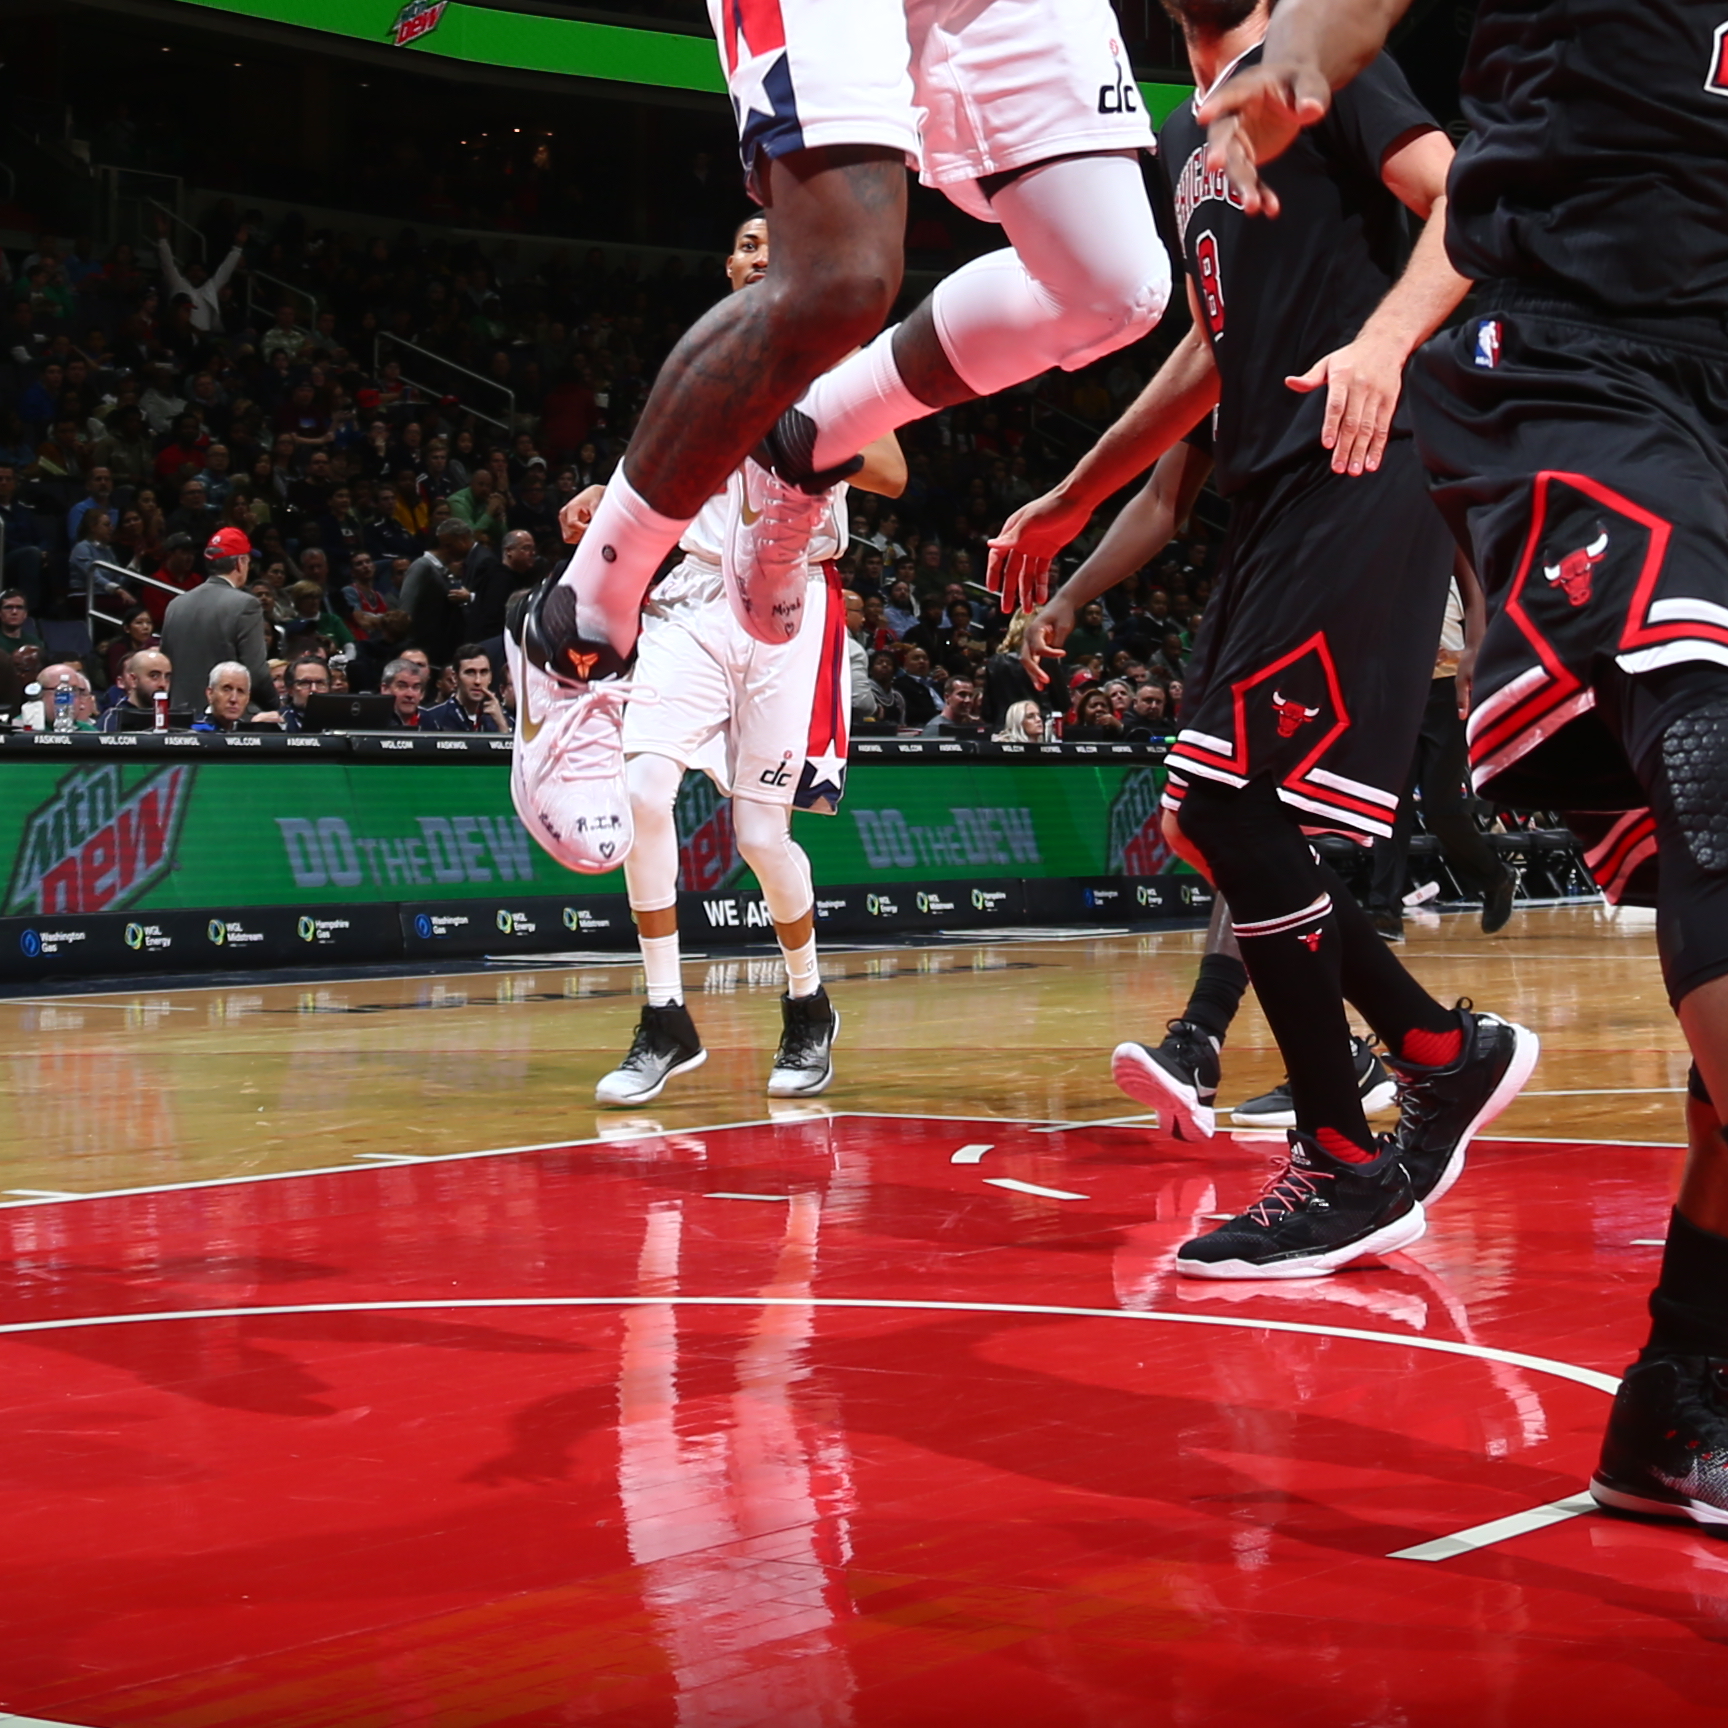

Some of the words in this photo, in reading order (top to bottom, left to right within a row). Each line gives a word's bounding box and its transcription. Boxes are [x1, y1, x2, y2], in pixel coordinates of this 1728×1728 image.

[274, 817, 364, 888] DO
[356, 837, 432, 886] THE
[414, 815, 534, 885] DEW
[851, 809, 912, 869] DO
[911, 825, 959, 869] THE
[949, 808, 1044, 866] DEW
[702, 899, 741, 928] WE
[747, 899, 774, 928] AR
